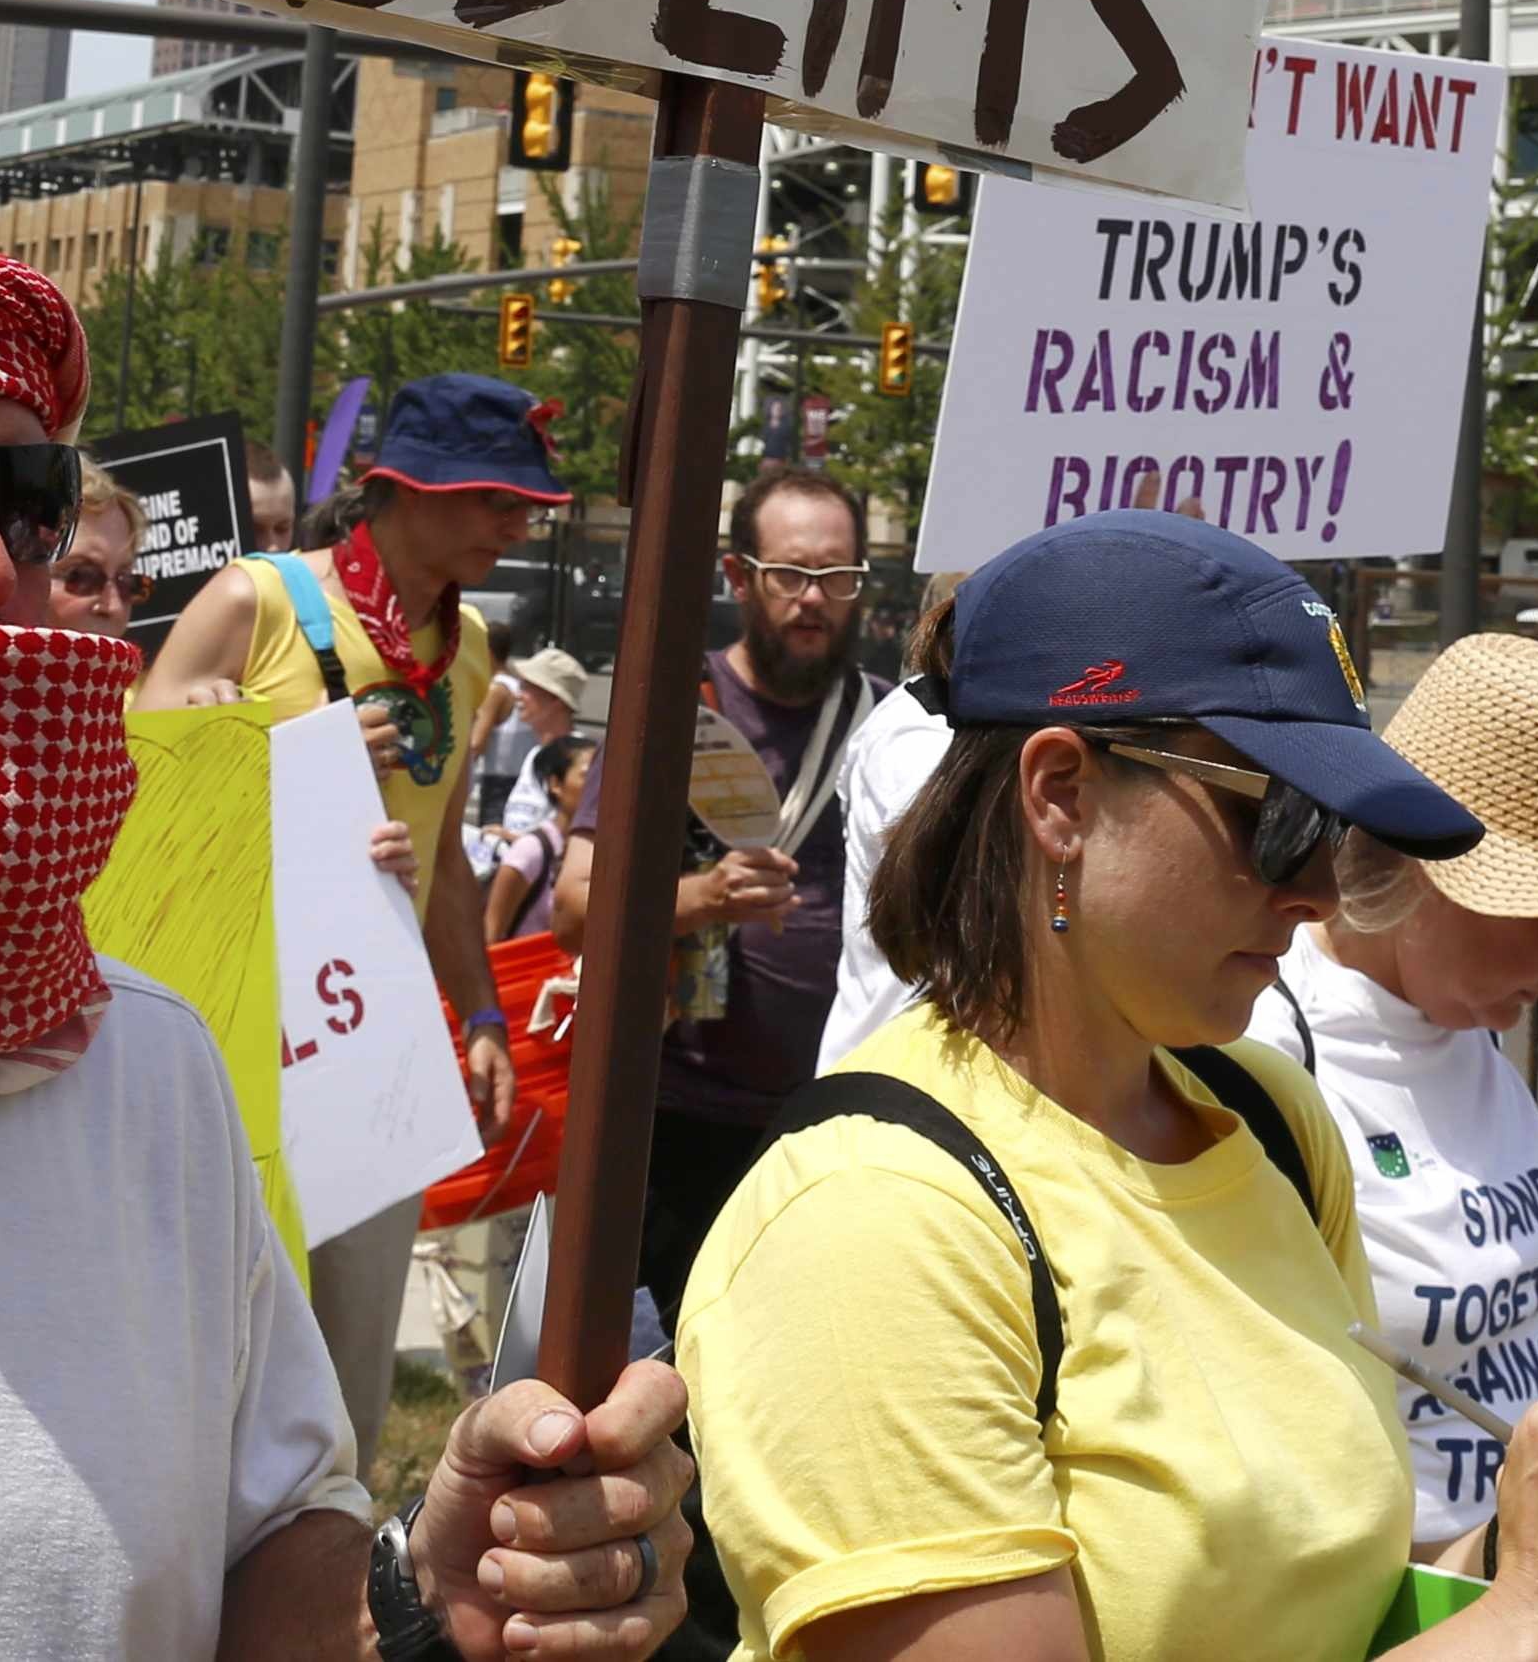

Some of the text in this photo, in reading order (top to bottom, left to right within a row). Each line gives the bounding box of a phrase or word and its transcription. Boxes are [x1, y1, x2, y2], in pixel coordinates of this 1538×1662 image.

[1335, 61, 1476, 153] WANT
[1097, 218, 1366, 306] TRUMP'S
[1024, 329, 1355, 414] RACISM &
[174, 516, 199, 545] OF
[1436, 1439, 1506, 1503] TR
